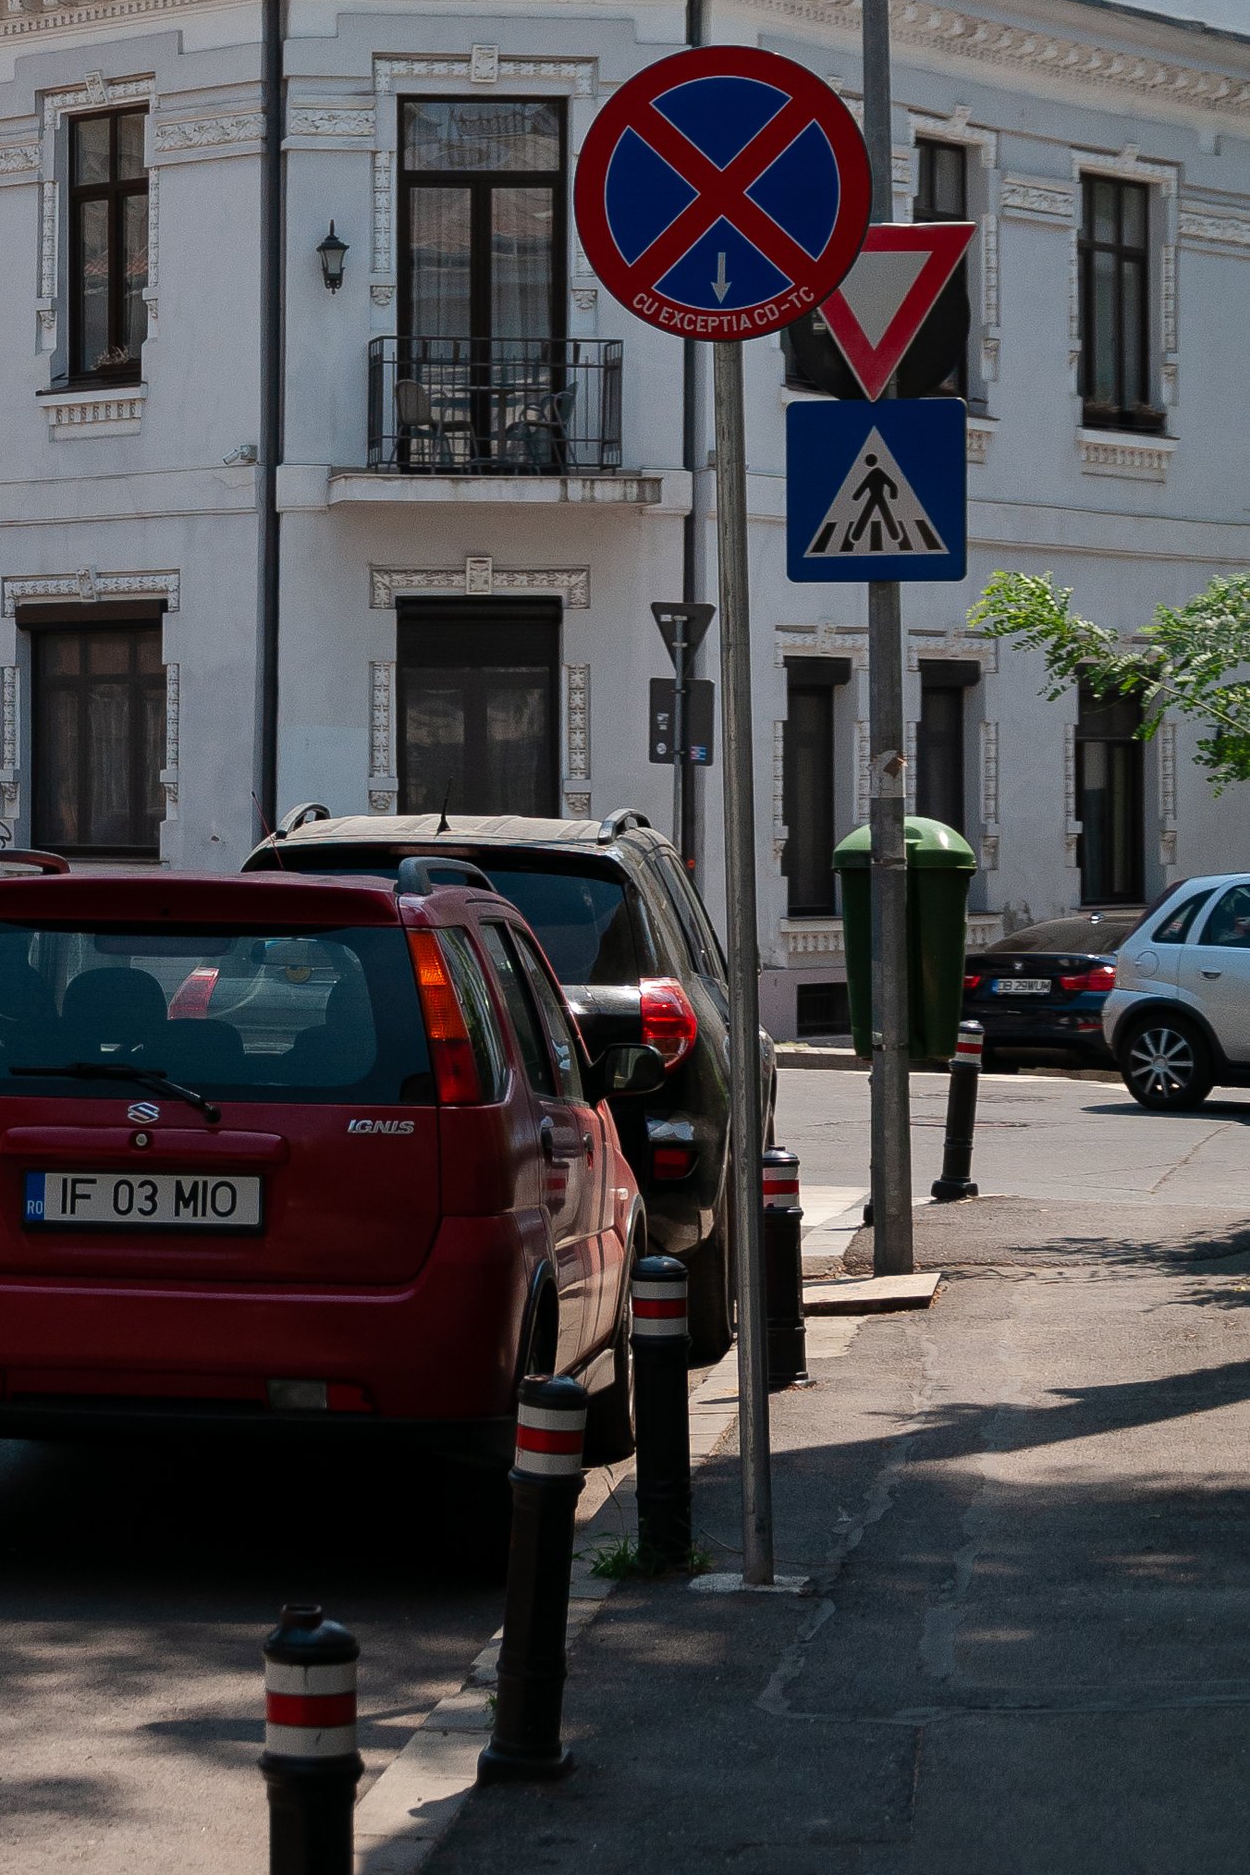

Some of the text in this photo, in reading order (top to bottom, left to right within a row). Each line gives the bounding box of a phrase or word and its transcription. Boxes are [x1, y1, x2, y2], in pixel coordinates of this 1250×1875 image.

[633, 286, 815, 333] CU EXCEPTIA CD-TC
[347, 1118, 415, 1134] IGNIS
[27, 1199, 43, 1215] RO
[61, 1177, 237, 1218] IF 03 MIO
